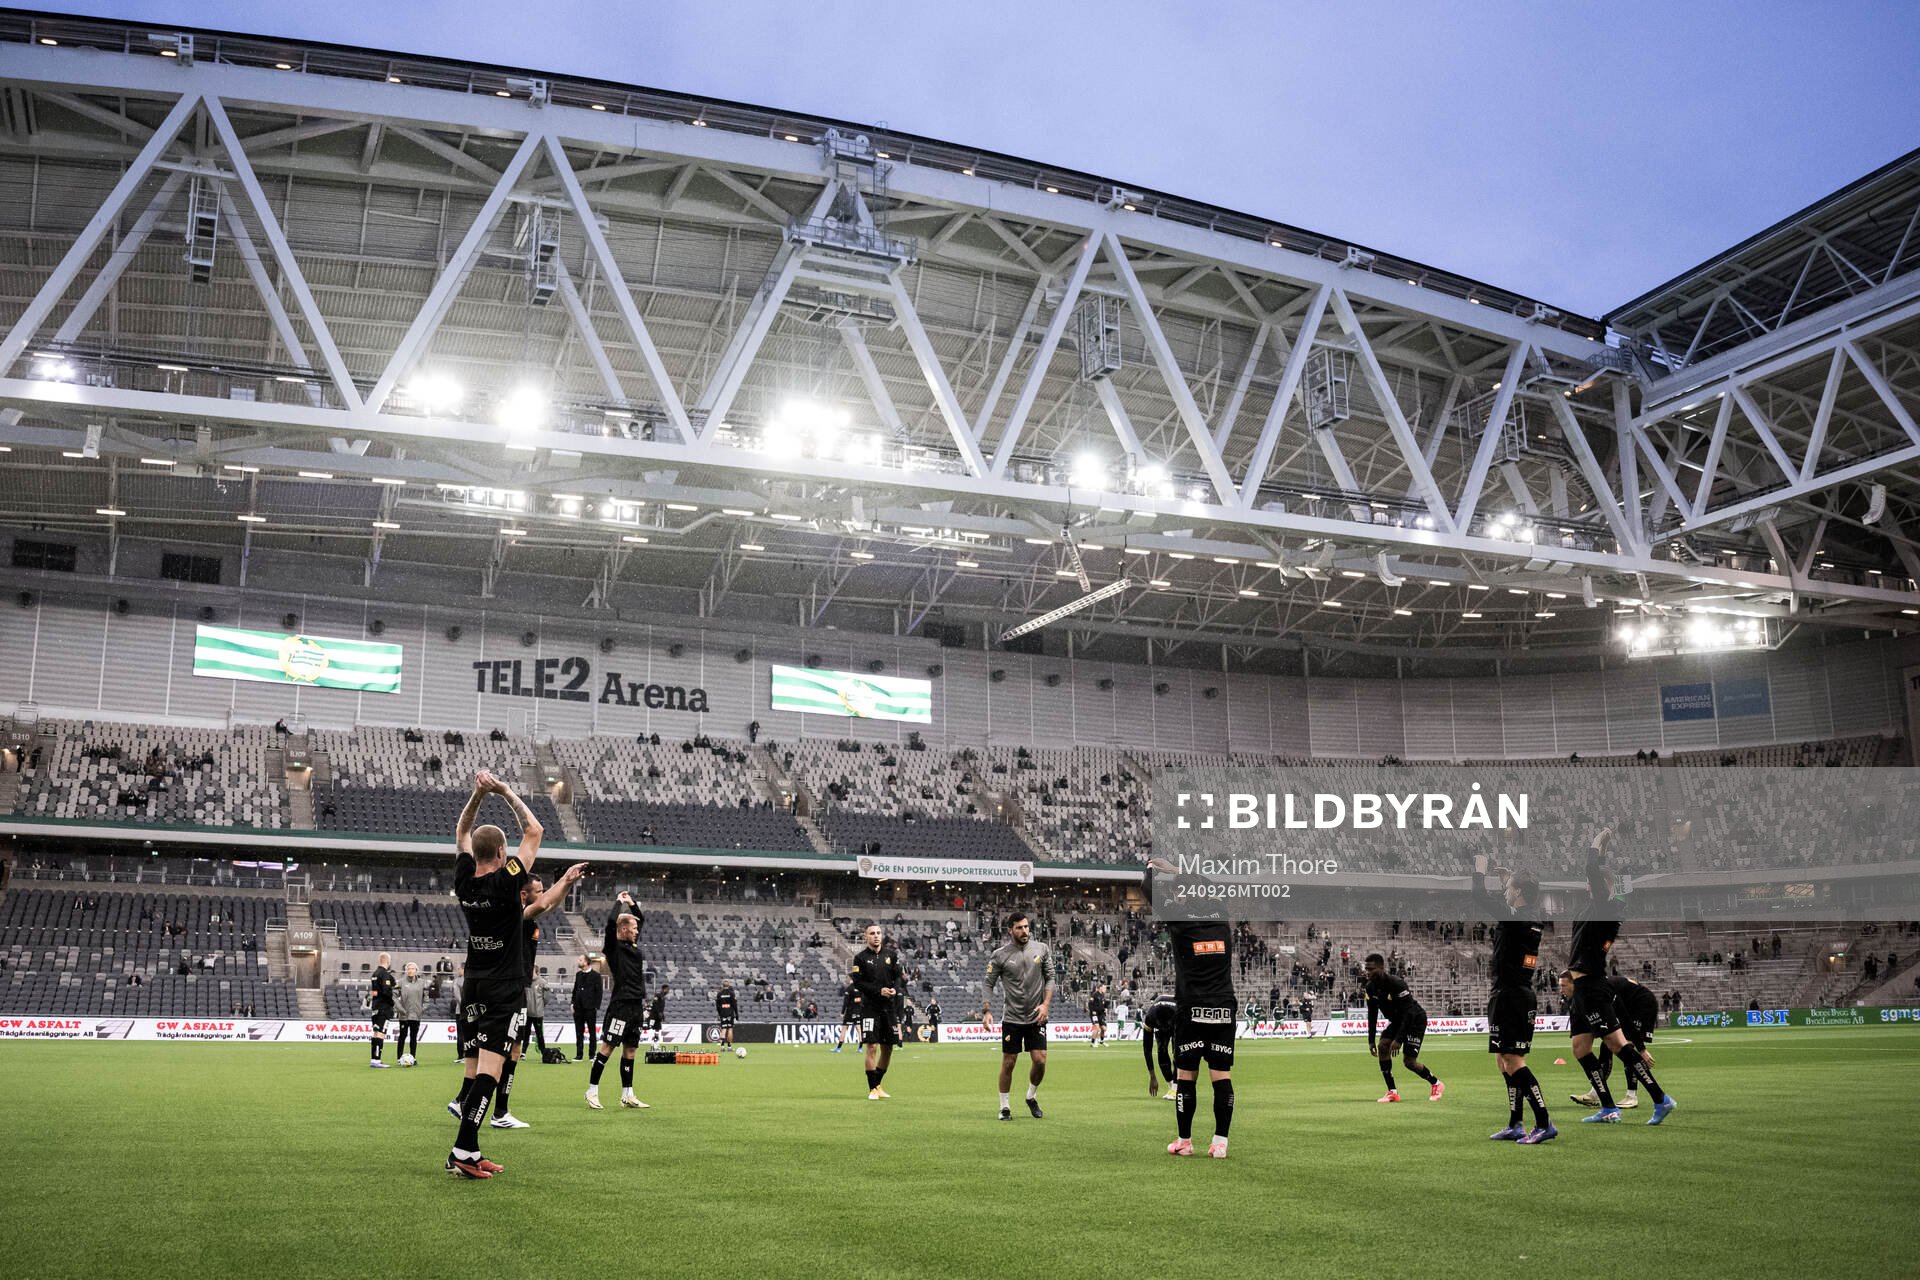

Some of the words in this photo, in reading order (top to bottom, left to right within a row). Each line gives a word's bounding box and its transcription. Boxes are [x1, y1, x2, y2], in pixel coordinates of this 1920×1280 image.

[473, 656, 590, 702] TELE2
[598, 672, 710, 713] Arena
[1664, 695, 1711, 704] AMERICAN
[1671, 701, 1712, 710] EXPRESS
[873, 863, 890, 873] FÖR
[893, 865, 904, 873] EN
[907, 865, 940, 875] POSITIV
[941, 866, 1018, 877] SUPPORTERKULTUR
[1191, 1007, 1231, 1019] DEMO
[1746, 1009, 1790, 1024] BST
[0, 1020, 23, 1028] GW
[27, 1020, 81, 1029] ASFALT
[1677, 1014, 1720, 1026] CRAFT
[1852, 1016, 1864, 1024] AB
[156, 1022, 179, 1030] GW
[182, 1022, 234, 1031] ASFALT
[306, 1024, 326, 1032] GW
[331, 1024, 372, 1032] ASFAL
[447, 1025, 457, 1033] G
[774, 1025, 859, 1043] ALLSVENSKA
